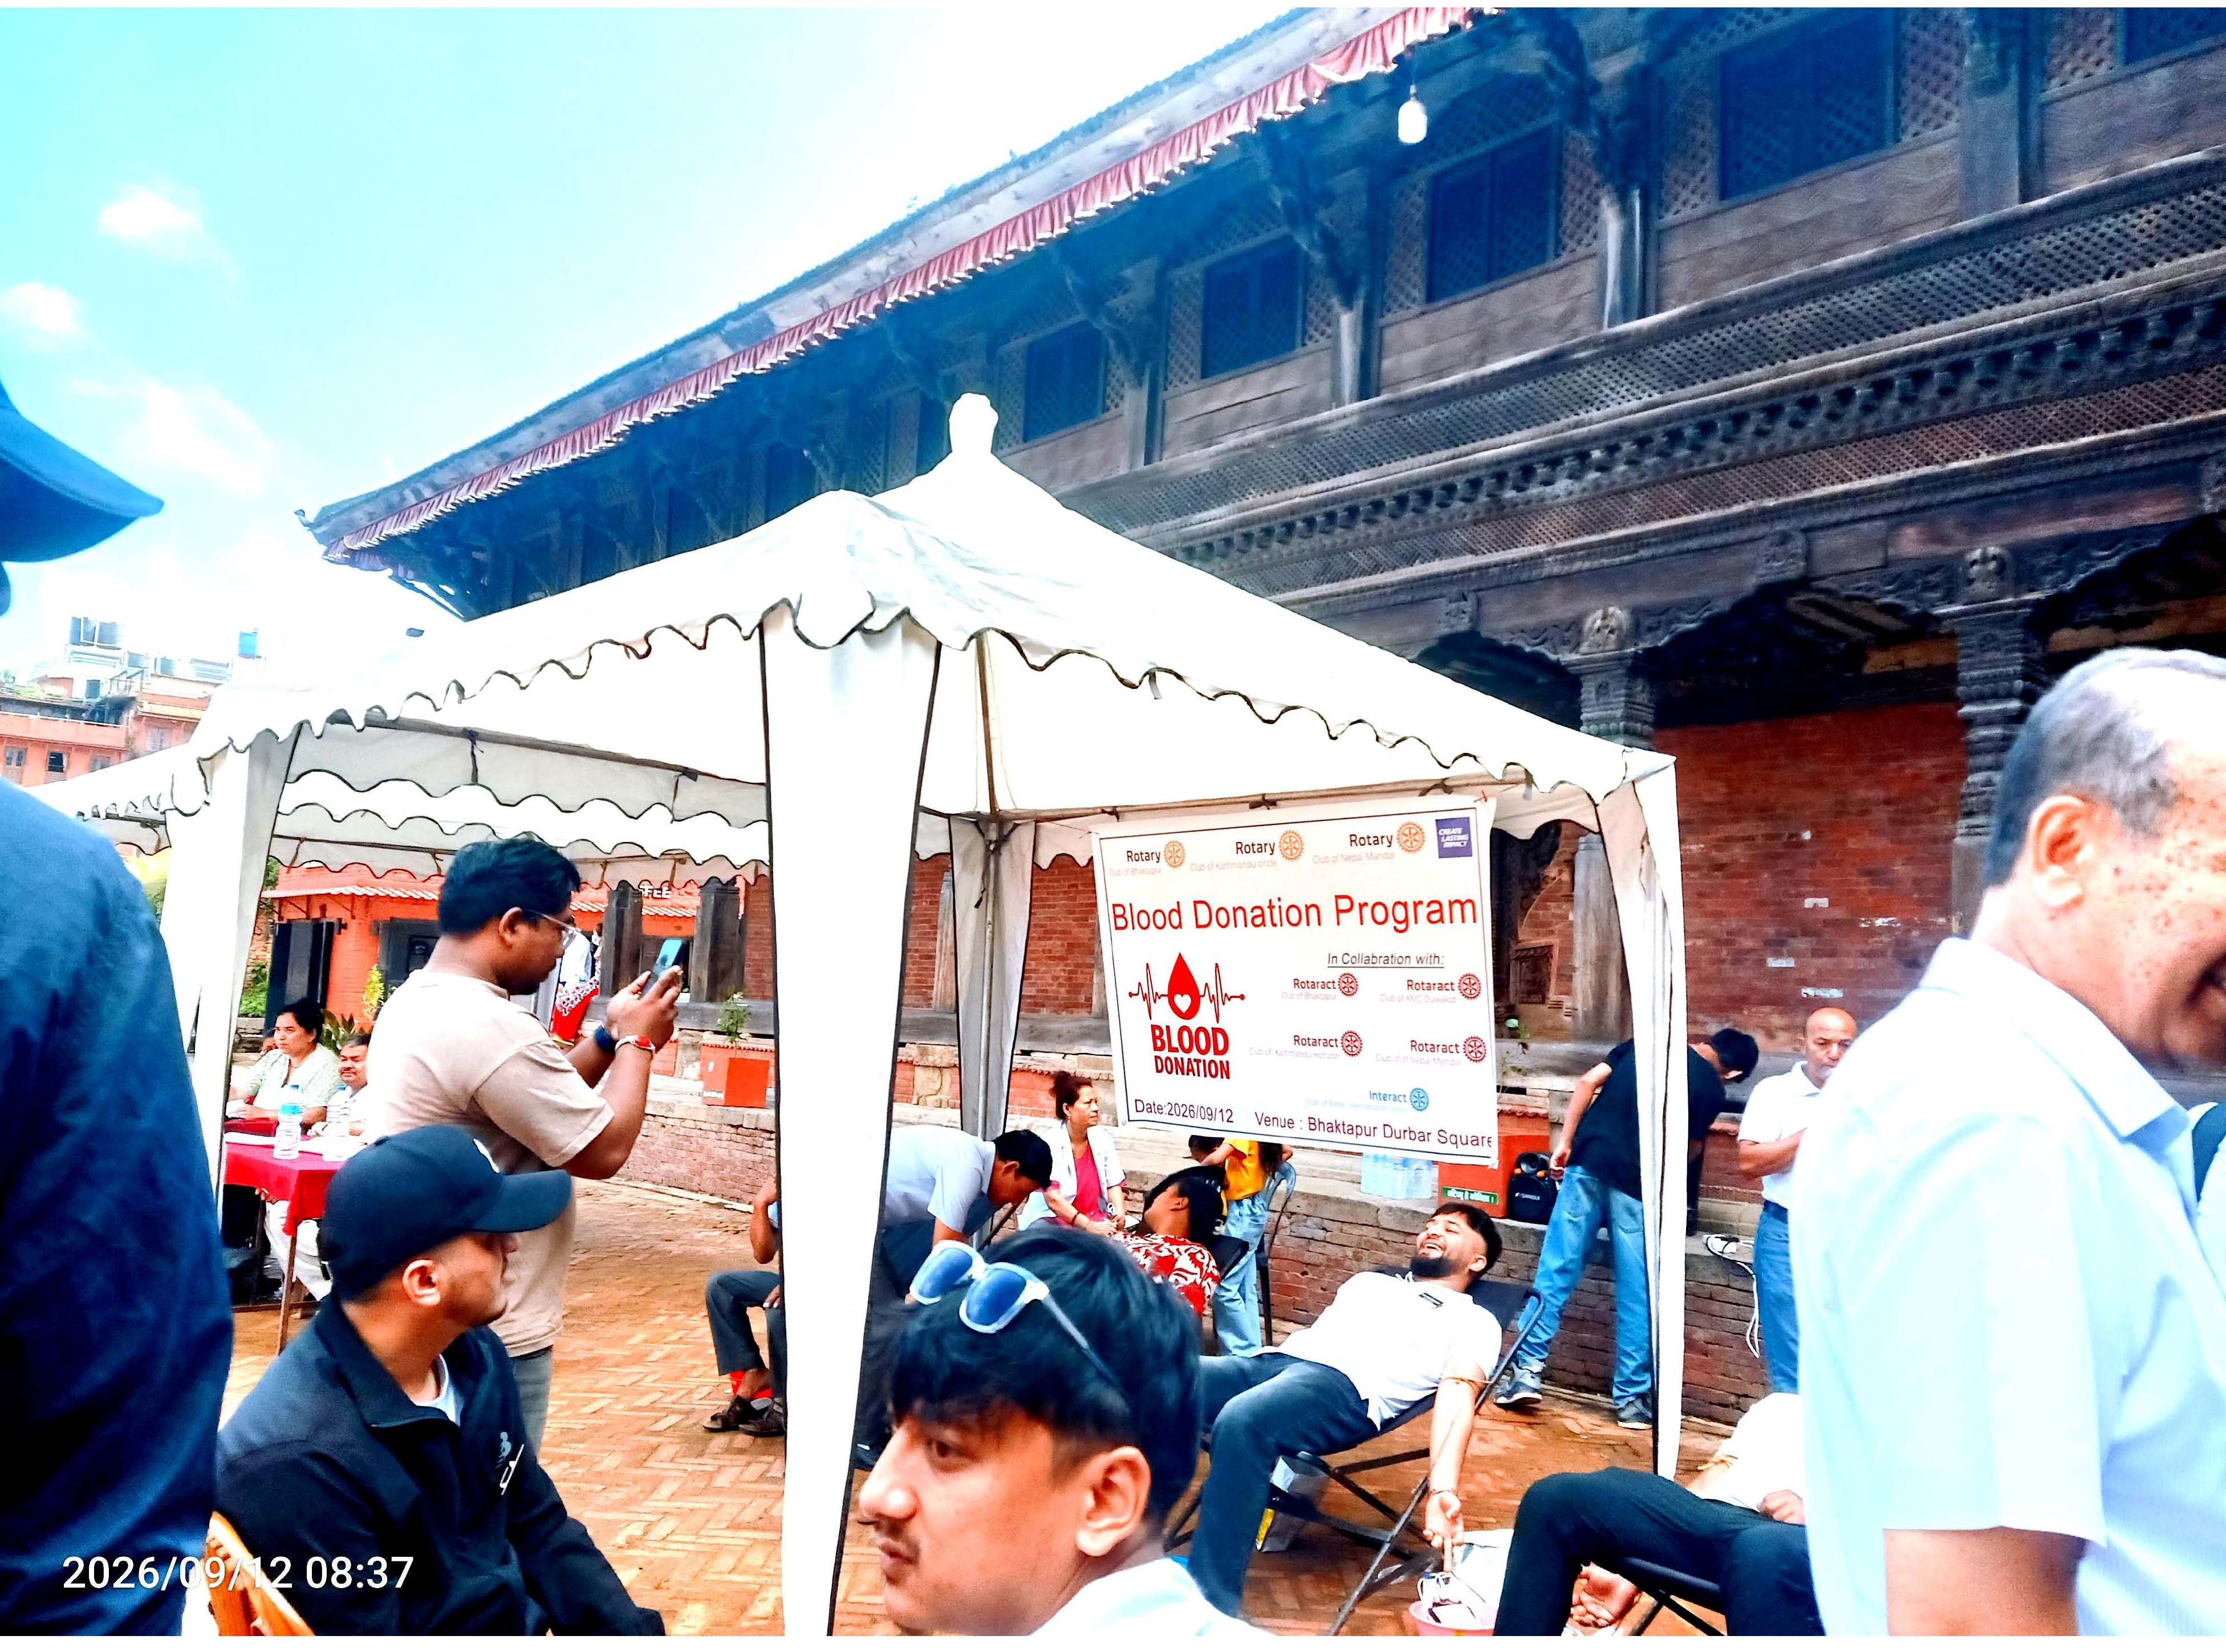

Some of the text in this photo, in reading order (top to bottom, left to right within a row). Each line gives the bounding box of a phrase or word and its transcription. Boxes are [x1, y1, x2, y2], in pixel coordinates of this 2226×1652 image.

[1349, 833, 1393, 847] Rotary
[1236, 841, 1276, 856] Rotary
[1126, 850, 1161, 862] Rotary
[1191, 862, 1205, 872] Club
[1207, 861, 1214, 870] of
[1112, 895, 1477, 934] Blood Donation Program
[1327, 953, 1445, 965] In Collabration with:
[1293, 978, 1337, 990] Rotaract
[1407, 979, 1455, 991] Rotaract
[1151, 1024, 1229, 1056] BLOOD
[1293, 1035, 1338, 1048] Rotaract
[1410, 1040, 1460, 1054] Rotaract
[1154, 1055, 1230, 1079] DONATION
[1369, 1089, 1407, 1103] Interact
[1135, 1098, 1234, 1123] Date:2026/09/12
[1254, 1112, 1295, 1129] Venue
[1307, 1117, 1378, 1138] Bhaktapur
[1383, 1124, 1431, 1142] Durbar
